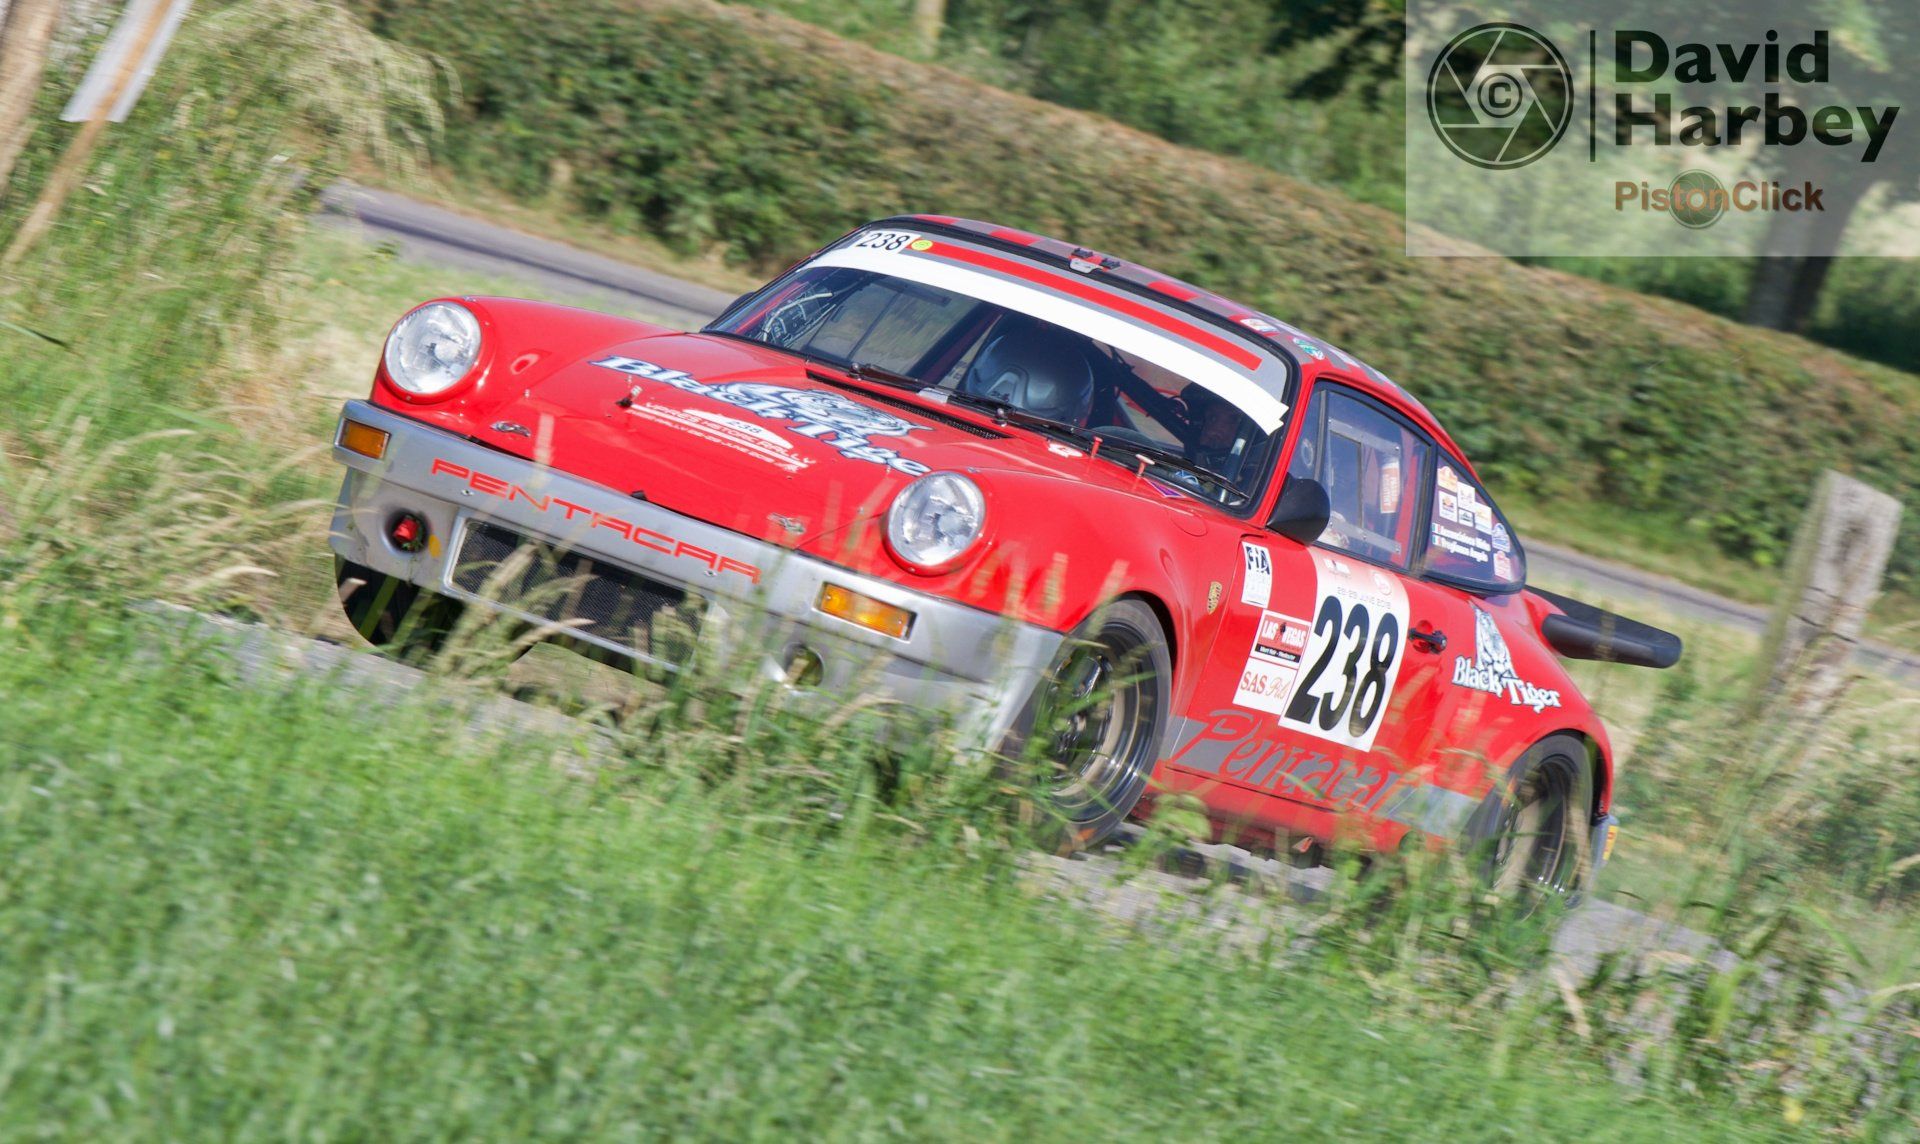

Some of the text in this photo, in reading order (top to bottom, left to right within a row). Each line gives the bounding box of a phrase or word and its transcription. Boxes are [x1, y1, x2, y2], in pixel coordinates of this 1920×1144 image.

[856, 232, 910, 251] 238
[588, 355, 932, 477] Black Tige
[727, 421, 763, 434] 238
[756, 441, 817, 464] RALLY
[431, 458, 763, 585] PENTACAR
[1261, 620, 1279, 641] LAS
[1281, 625, 1307, 648] VEGAS
[1285, 595, 1399, 738] 238
[1240, 670, 1268, 695] SAS
[1452, 655, 1562, 713] Black Tiger
